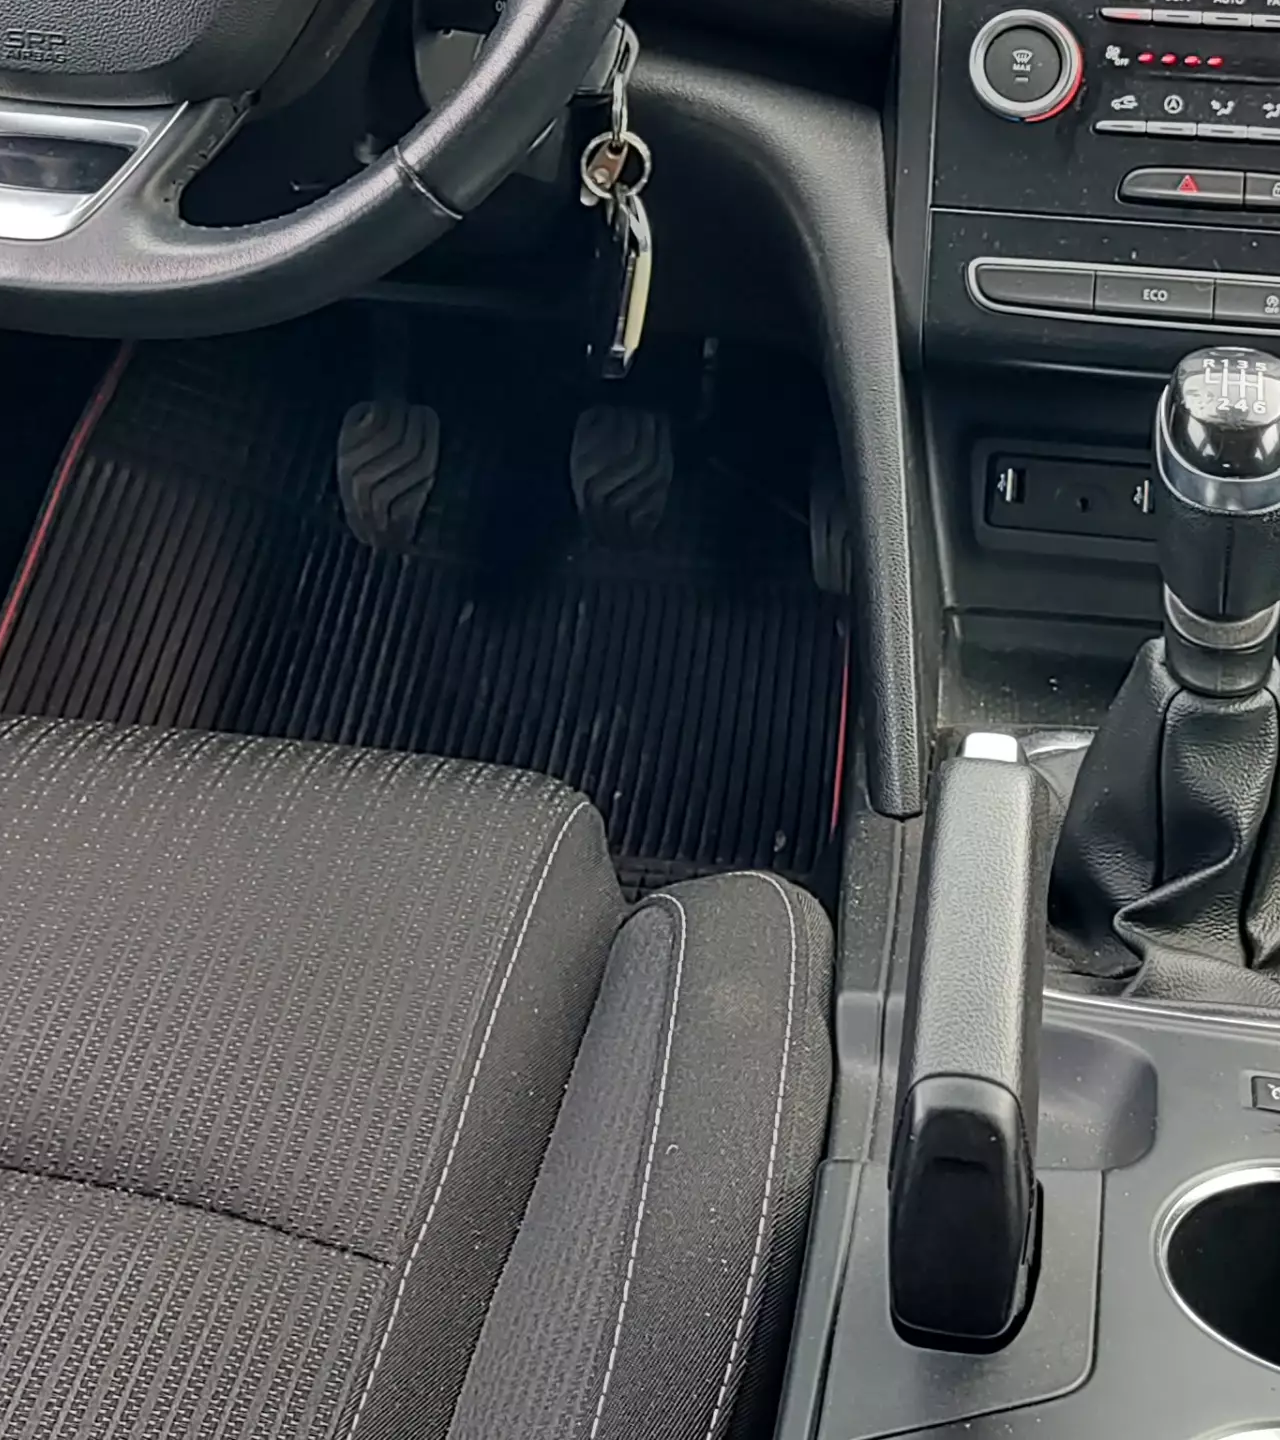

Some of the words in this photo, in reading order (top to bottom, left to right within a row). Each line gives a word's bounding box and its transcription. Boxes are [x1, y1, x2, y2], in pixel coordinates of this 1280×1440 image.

[1012, 63, 1031, 72] MAX
[1114, 57, 1130, 67] OFF
[1142, 288, 1168, 302] ECO
[1202, 358, 1216, 368] R
[1220, 358, 1229, 368] 1
[1236, 359, 1249, 369] 3
[1255, 362, 1267, 372] 5
[1217, 397, 1230, 411] 2
[1234, 397, 1249, 412] 4
[1252, 400, 1267, 414] 6
